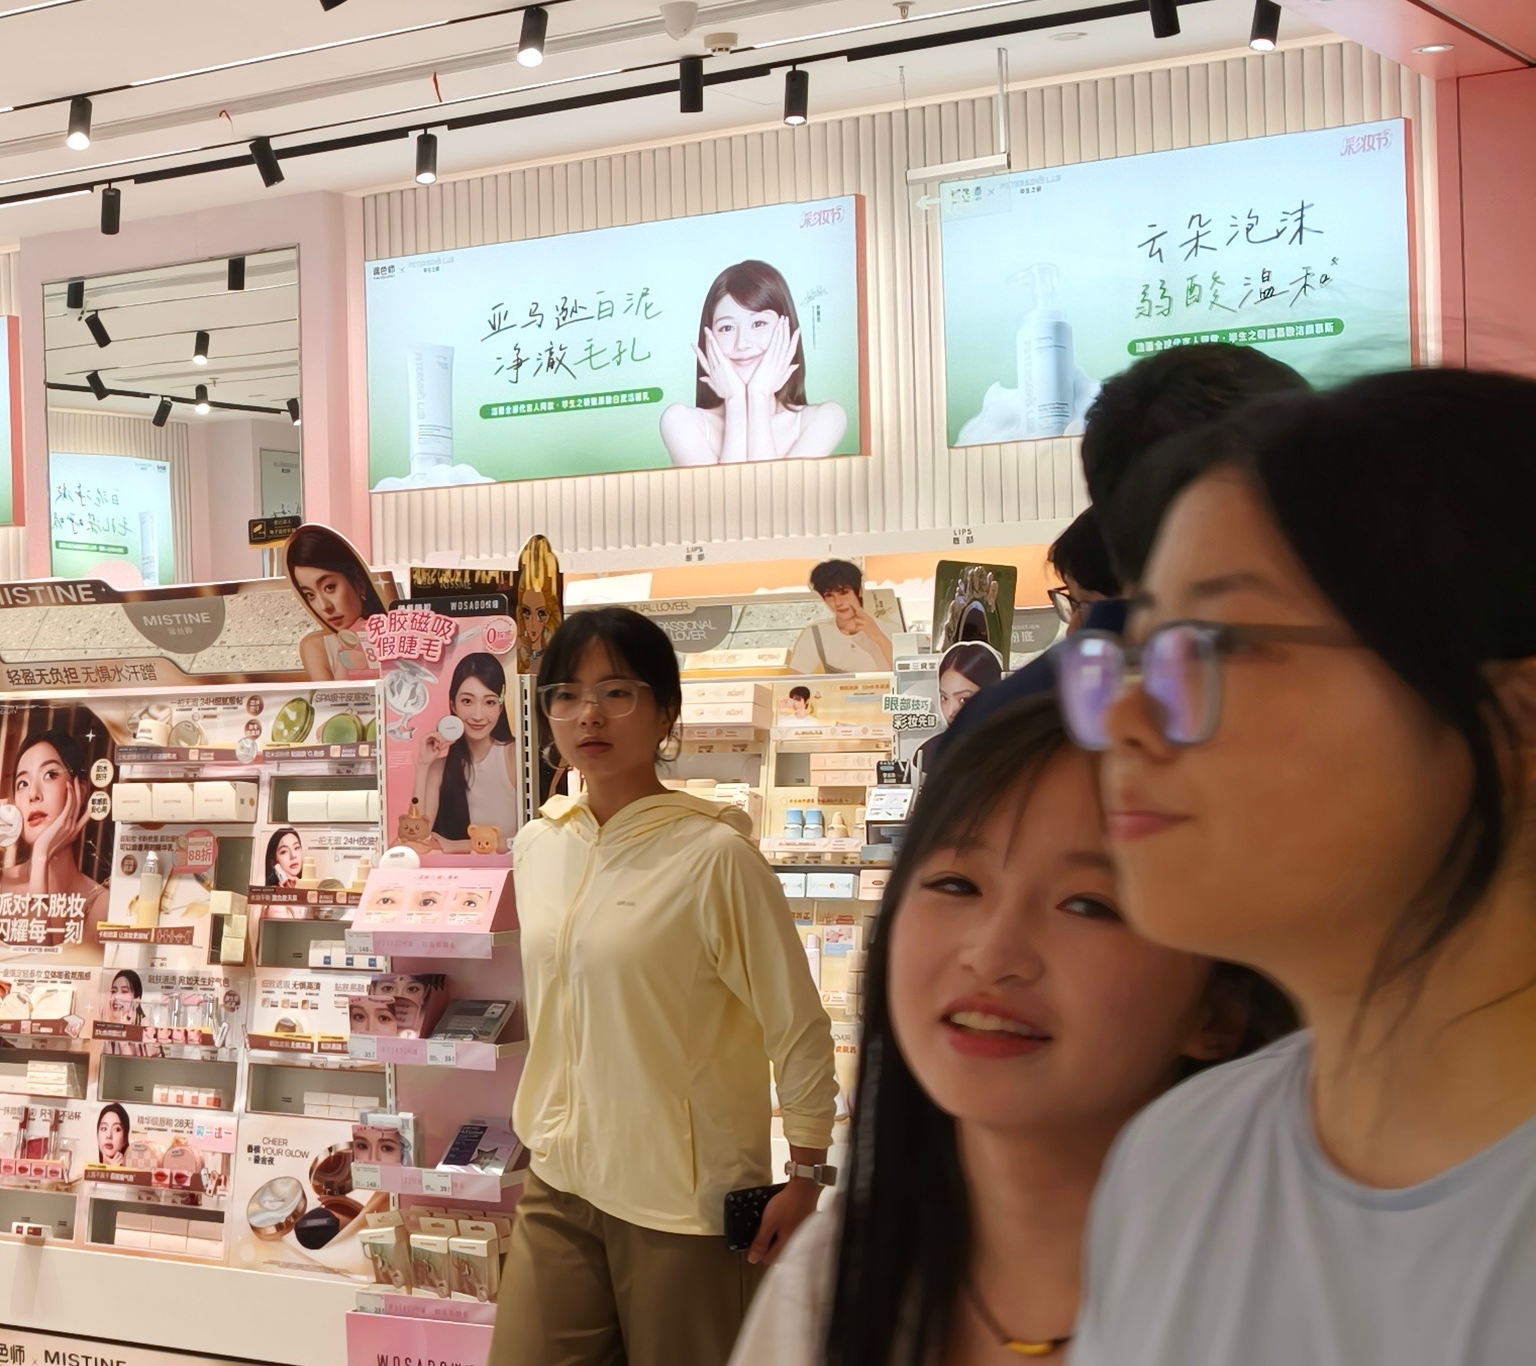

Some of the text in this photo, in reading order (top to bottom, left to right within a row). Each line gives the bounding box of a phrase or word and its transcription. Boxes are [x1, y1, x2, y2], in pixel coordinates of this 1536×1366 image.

[1137, 200, 1325, 263] 云朵泡沫
[480, 287, 663, 342] 亚马逊白泥
[494, 337, 652, 384] 净澈毛孔
[142, 611, 212, 628] MISTINE
[368, 612, 456, 645] 免胶磁吸
[378, 635, 444, 660] 假睫毛
[6, 667, 81, 686] 轻盈无负担
[262, 1136, 288, 1147] CHEER
[262, 1147, 310, 1160] YOUR GLOW
